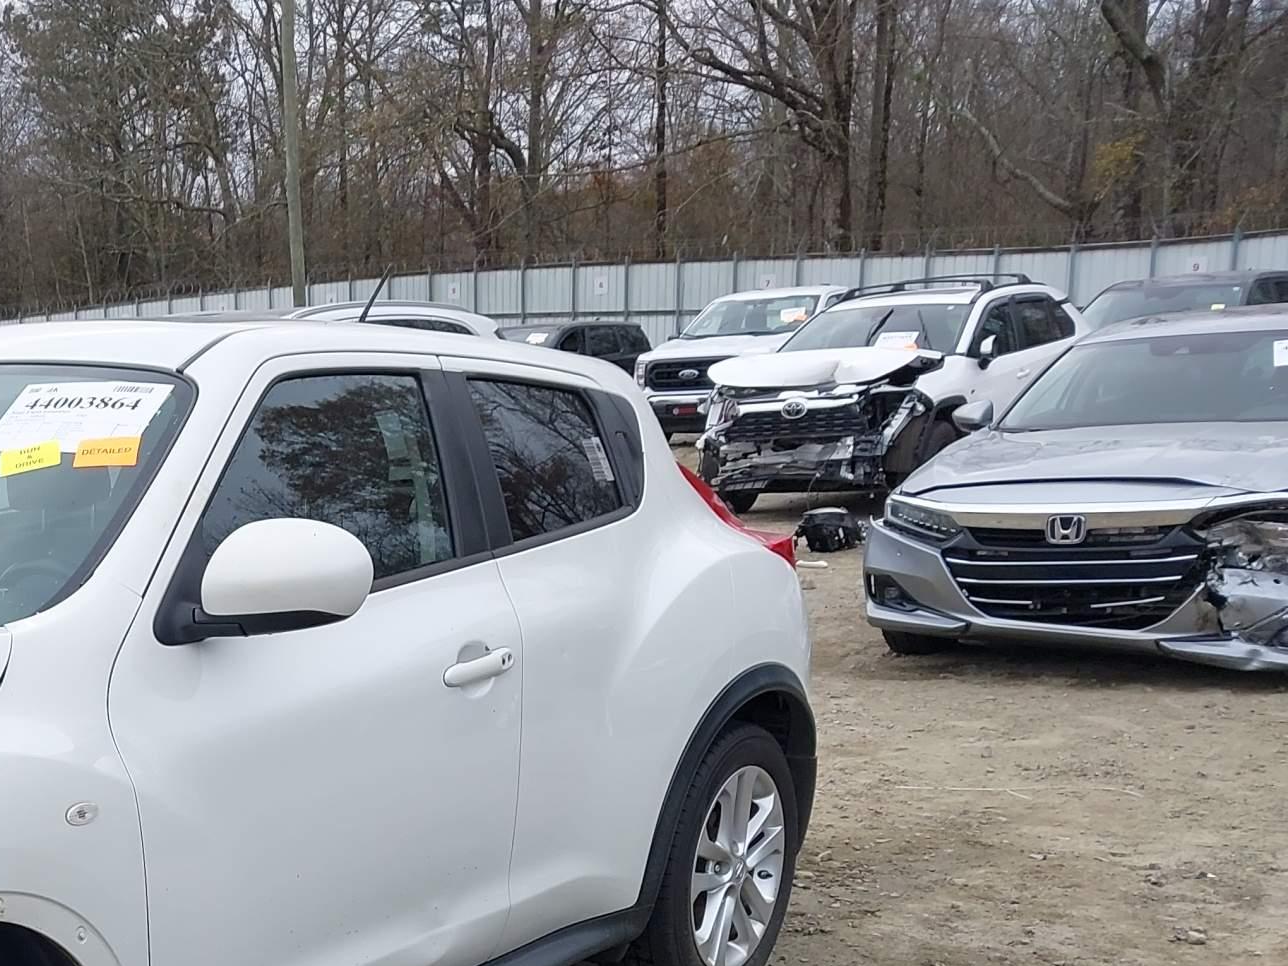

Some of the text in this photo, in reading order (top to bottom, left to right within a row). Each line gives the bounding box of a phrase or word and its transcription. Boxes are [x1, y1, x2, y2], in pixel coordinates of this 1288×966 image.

[1192, 263, 1200, 272] 9
[765, 279, 771, 288] 7
[25, 397, 142, 410] 44003864
[81, 446, 133, 456] DETAILED
[15, 458, 45, 469] DRIVE
